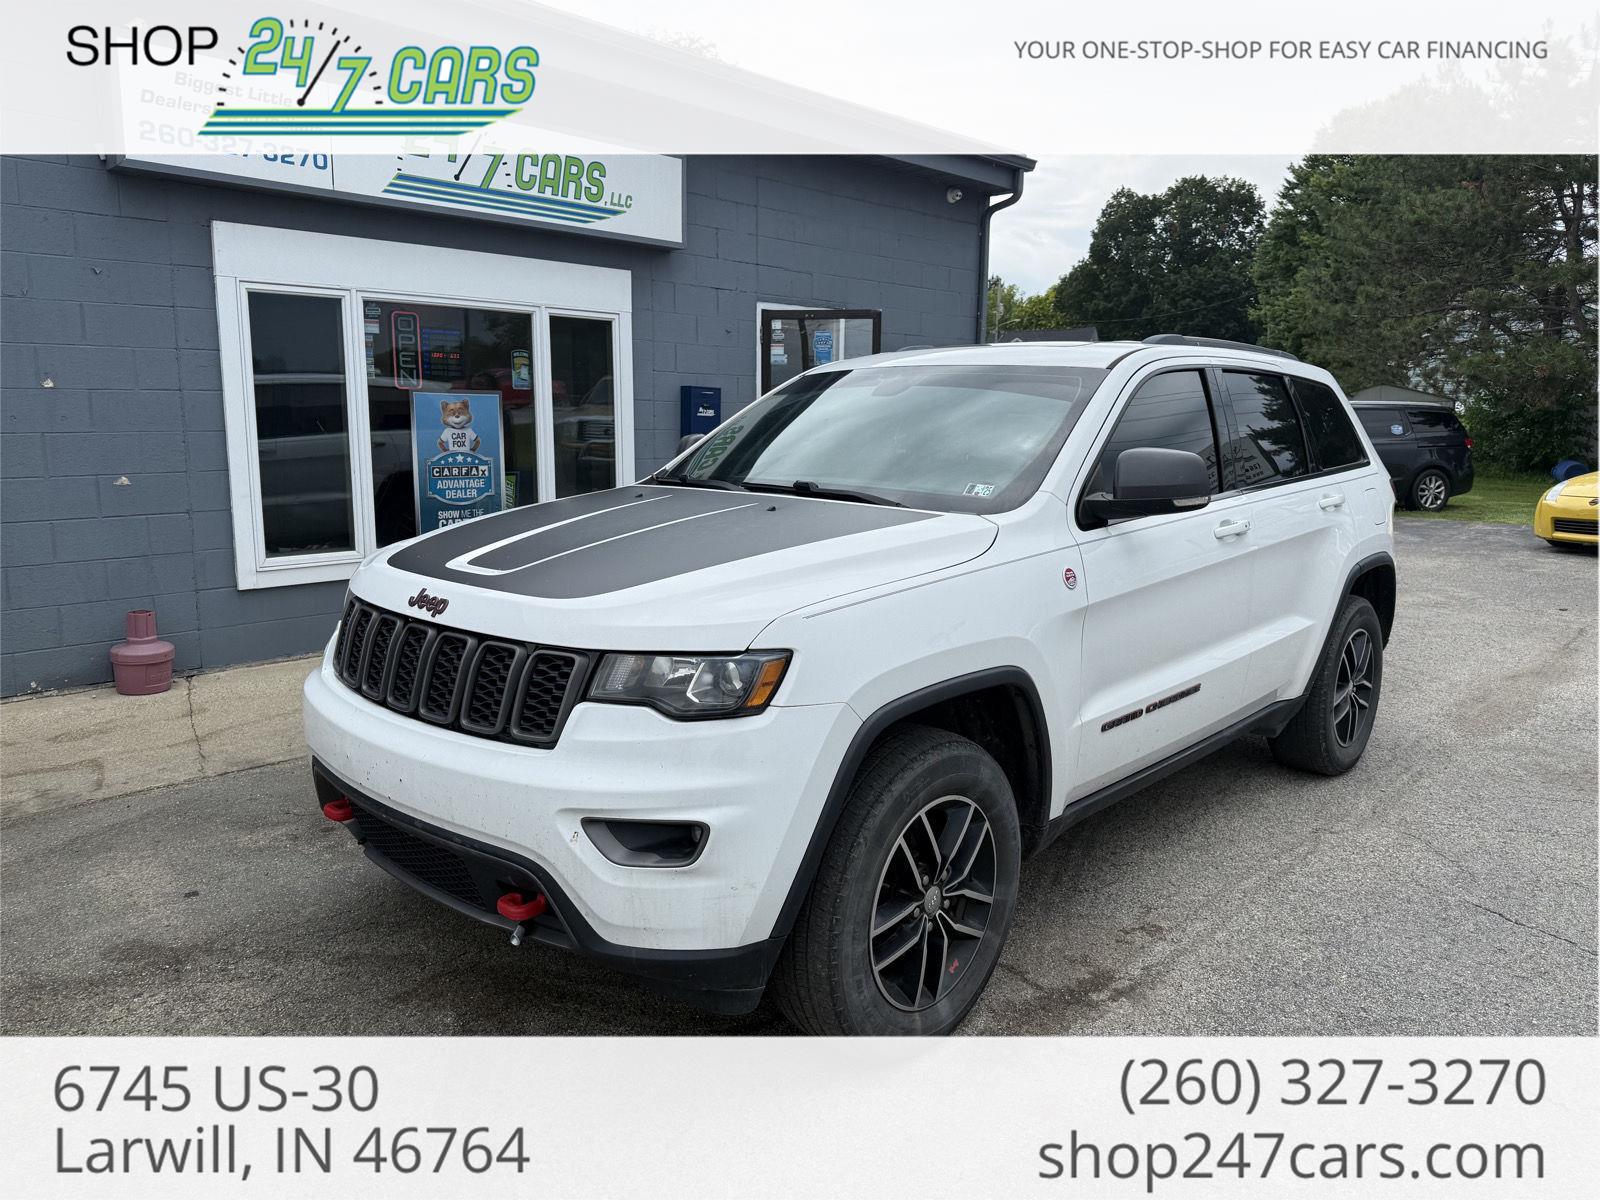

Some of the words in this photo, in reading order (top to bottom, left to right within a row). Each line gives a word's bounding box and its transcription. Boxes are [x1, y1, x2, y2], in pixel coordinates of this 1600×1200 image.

[140, 88, 218, 116] Dealers
[514, 148, 607, 202] CARS
[397, 316, 418, 386] OPEN
[451, 432, 467, 440] CAR
[432, 465, 489, 477] CARFAX
[436, 479, 486, 489] ADVANTAGE
[445, 490, 477, 499] DEALER
[437, 510, 459, 519] SHOW
[460, 509, 472, 518] ME
[408, 587, 450, 618] Jeep
